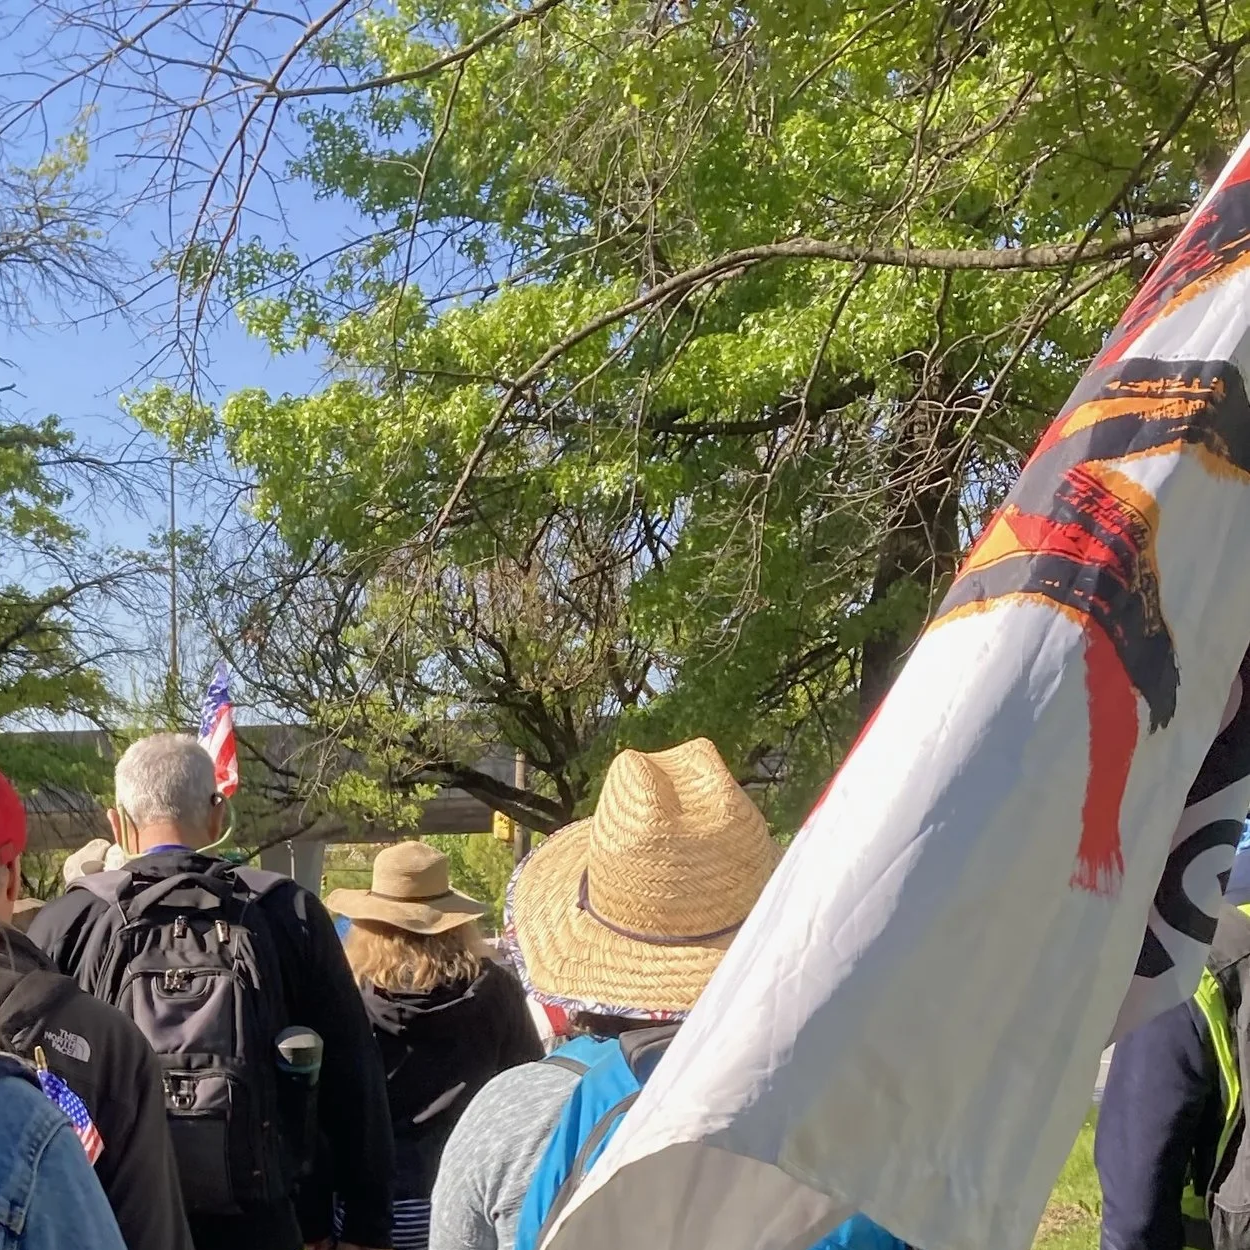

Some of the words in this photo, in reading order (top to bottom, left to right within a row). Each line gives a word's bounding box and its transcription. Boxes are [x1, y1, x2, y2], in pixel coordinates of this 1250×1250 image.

[44, 1031, 77, 1050] NORTH
[59, 1028, 78, 1042] THE
[52, 1040, 75, 1056] FACE
